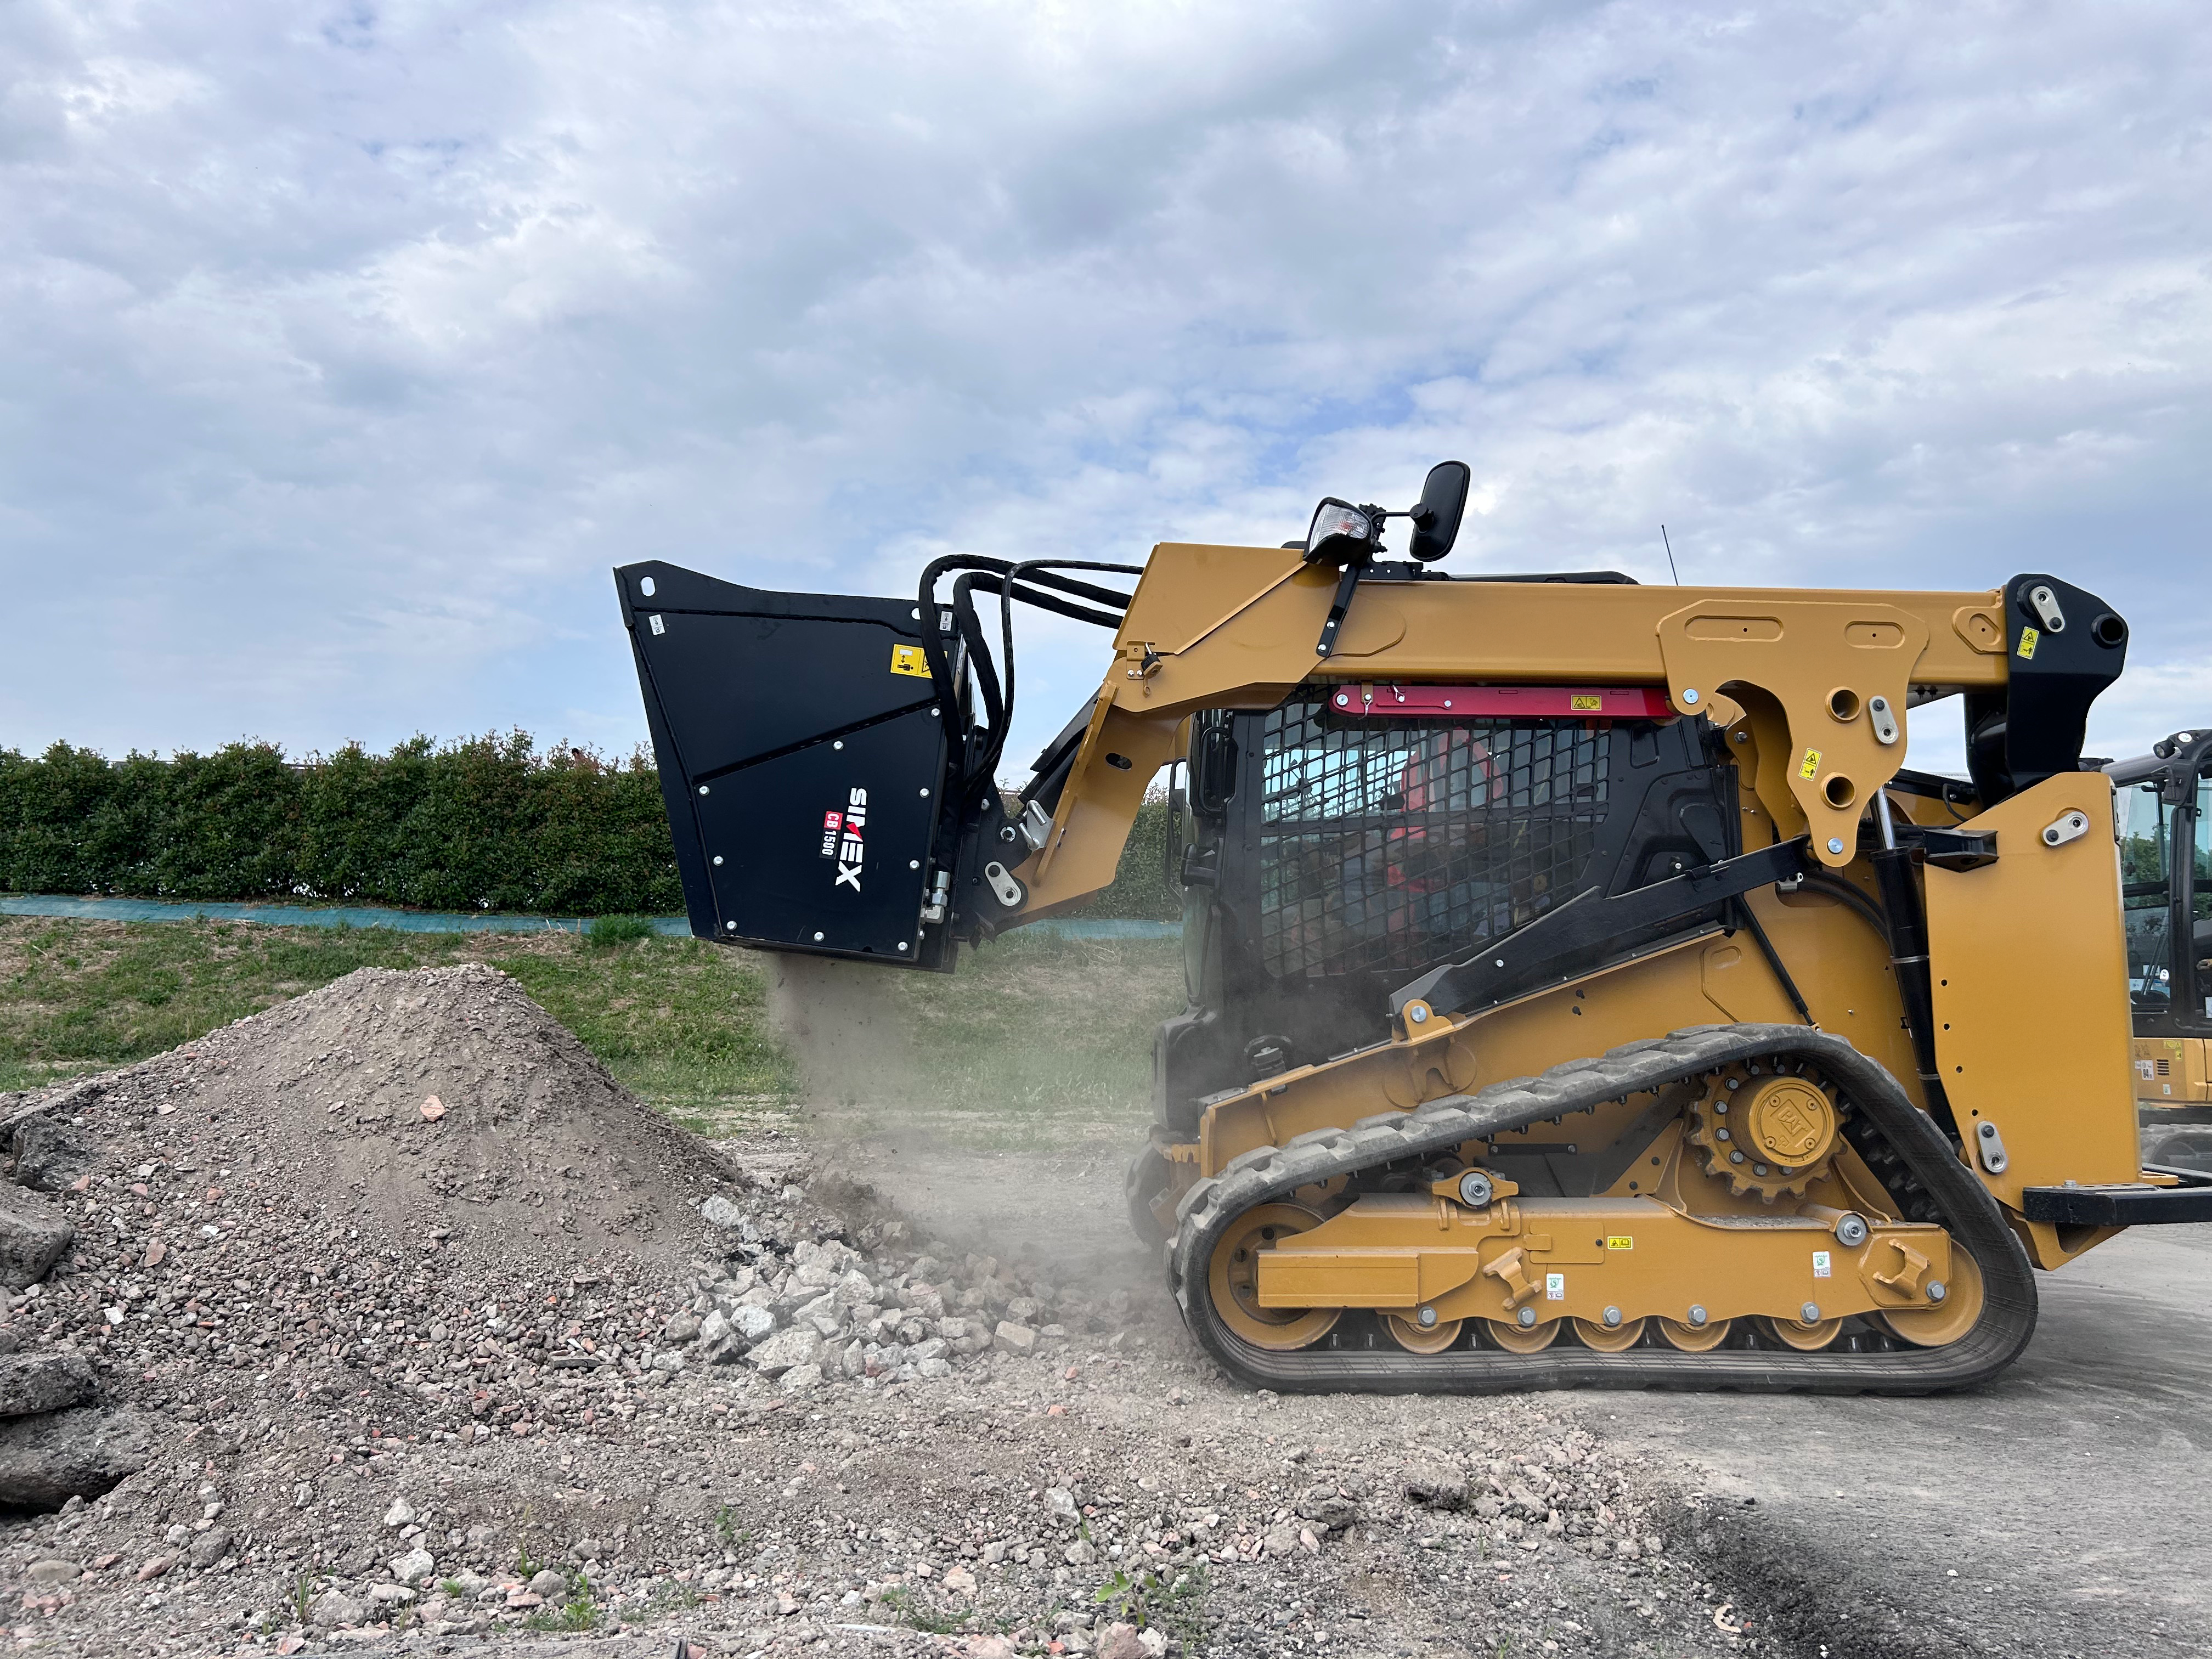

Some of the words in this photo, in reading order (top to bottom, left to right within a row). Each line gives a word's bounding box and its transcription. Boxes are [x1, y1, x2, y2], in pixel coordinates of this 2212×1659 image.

[827, 813, 839, 828] CB
[822, 830, 837, 855] 1500
[836, 788, 867, 892] SIMEX
[1778, 1107, 1808, 1137] CAT
